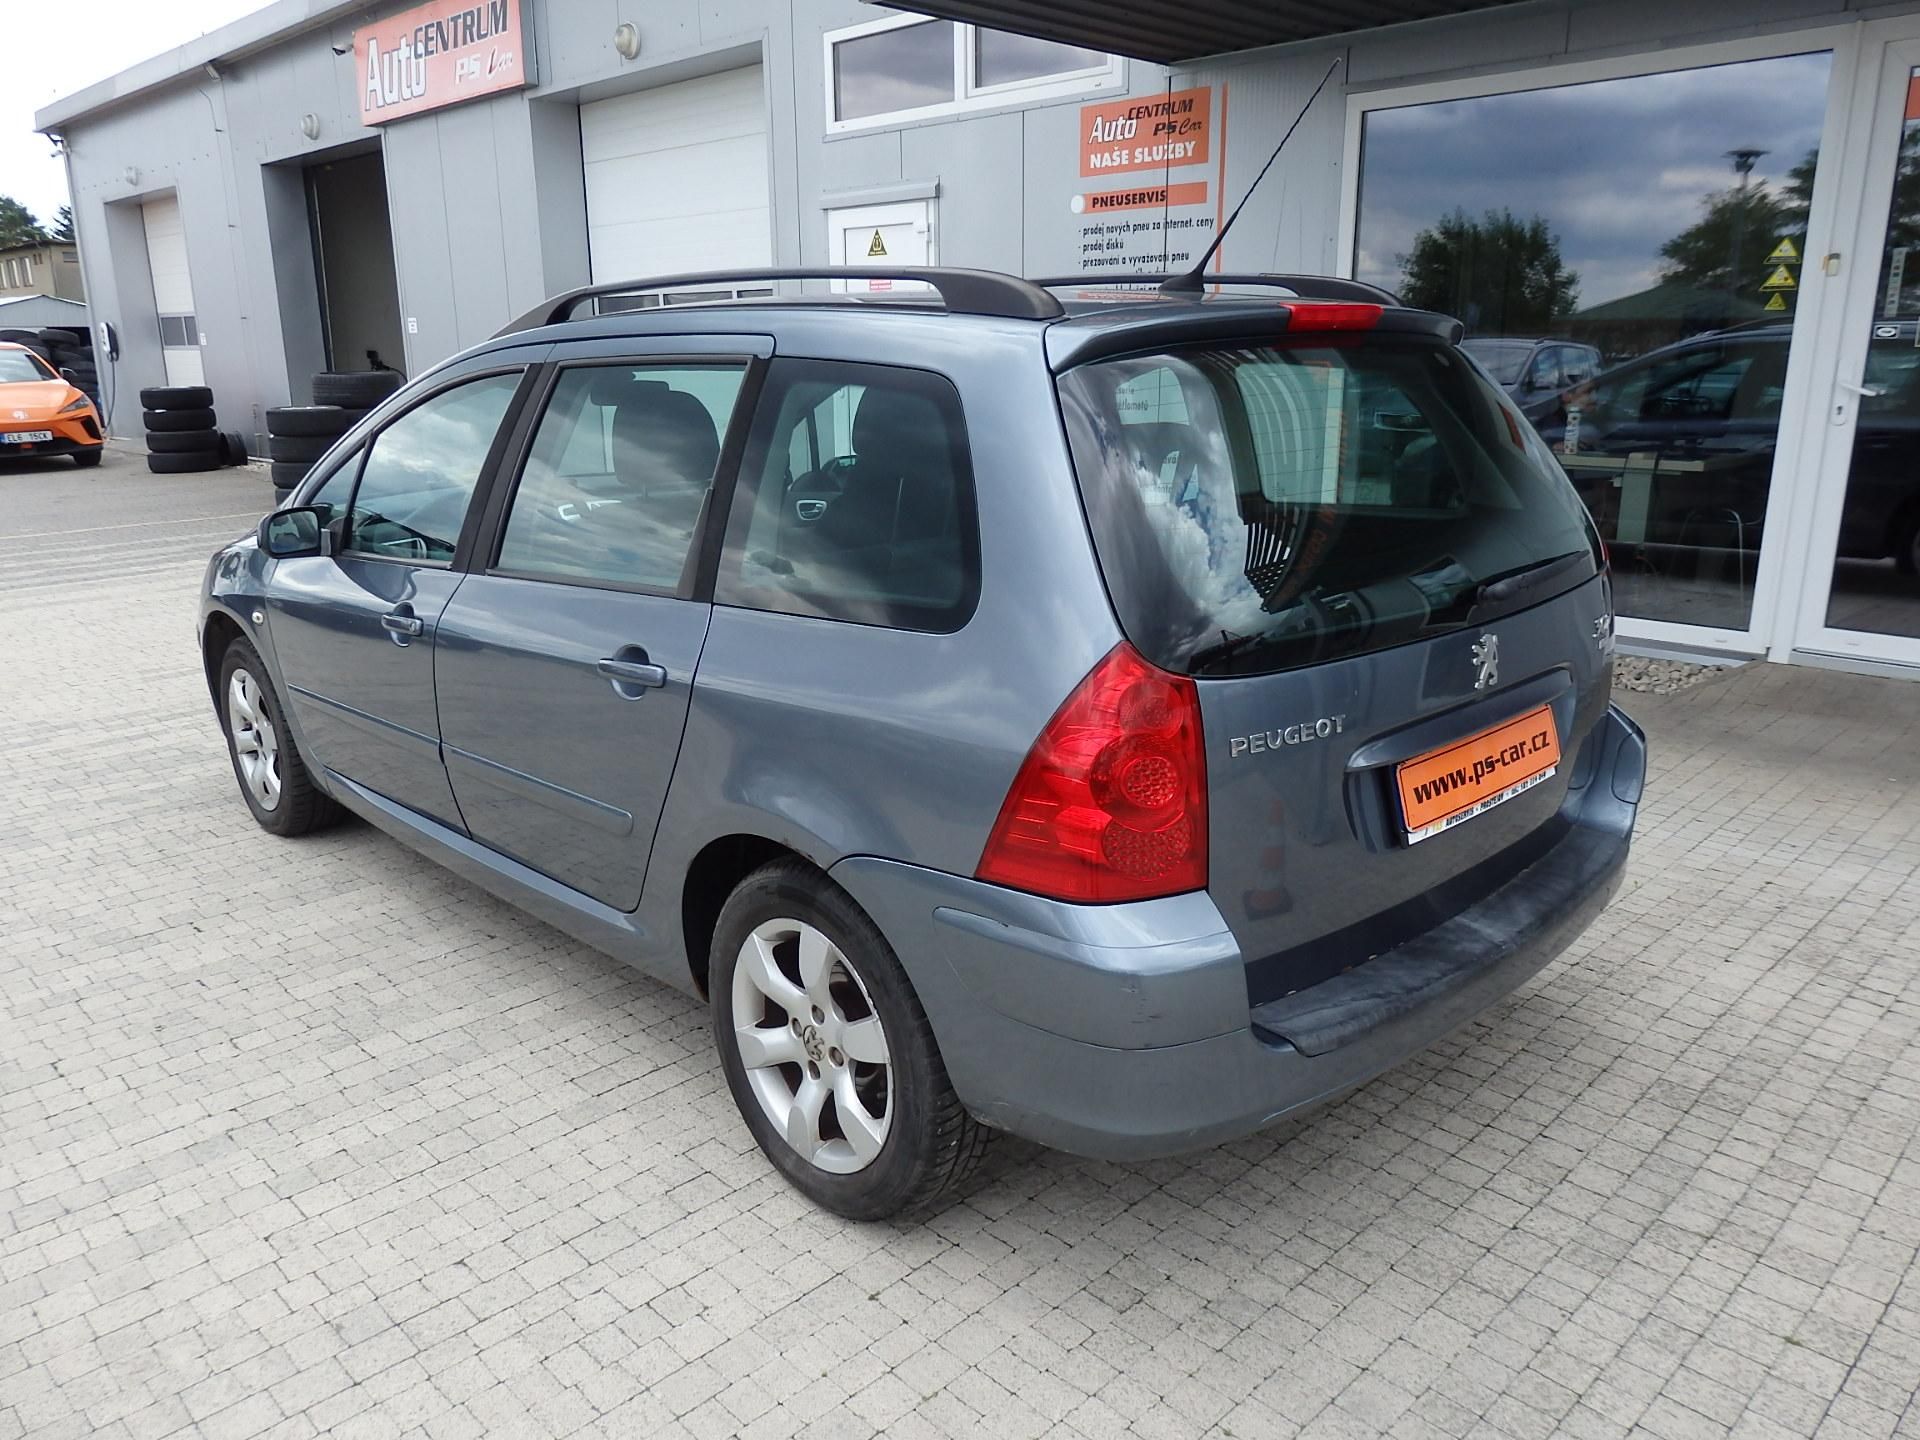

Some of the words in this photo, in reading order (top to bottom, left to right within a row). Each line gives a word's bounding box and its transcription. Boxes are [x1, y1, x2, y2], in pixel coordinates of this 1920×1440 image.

[365, 34, 427, 111] Auto
[413, 1, 508, 60] CENTRUM
[455, 53, 481, 84] PS
[1088, 114, 1138, 144] Auto
[1128, 98, 1194, 120] CENTRUM
[1153, 121, 1178, 136] PS
[1178, 118, 1202, 135] Car
[1090, 146, 1129, 168] NAŠE
[1134, 140, 1196, 163] SLUŽBY
[1092, 190, 1167, 208] PNEUSERVIS
[1083, 224, 1104, 237] prodej
[1106, 221, 1130, 235] nových
[1132, 222, 1150, 234] pneu
[1152, 222, 1161, 230] za
[1196, 217, 1215, 229] ceny
[1083, 240, 1104, 254] prodej
[1172, 252, 1190, 264] pneu
[1230, 714, 1347, 758] PEUGEOT
[1413, 731, 1550, 804] www.ps-car.cz
